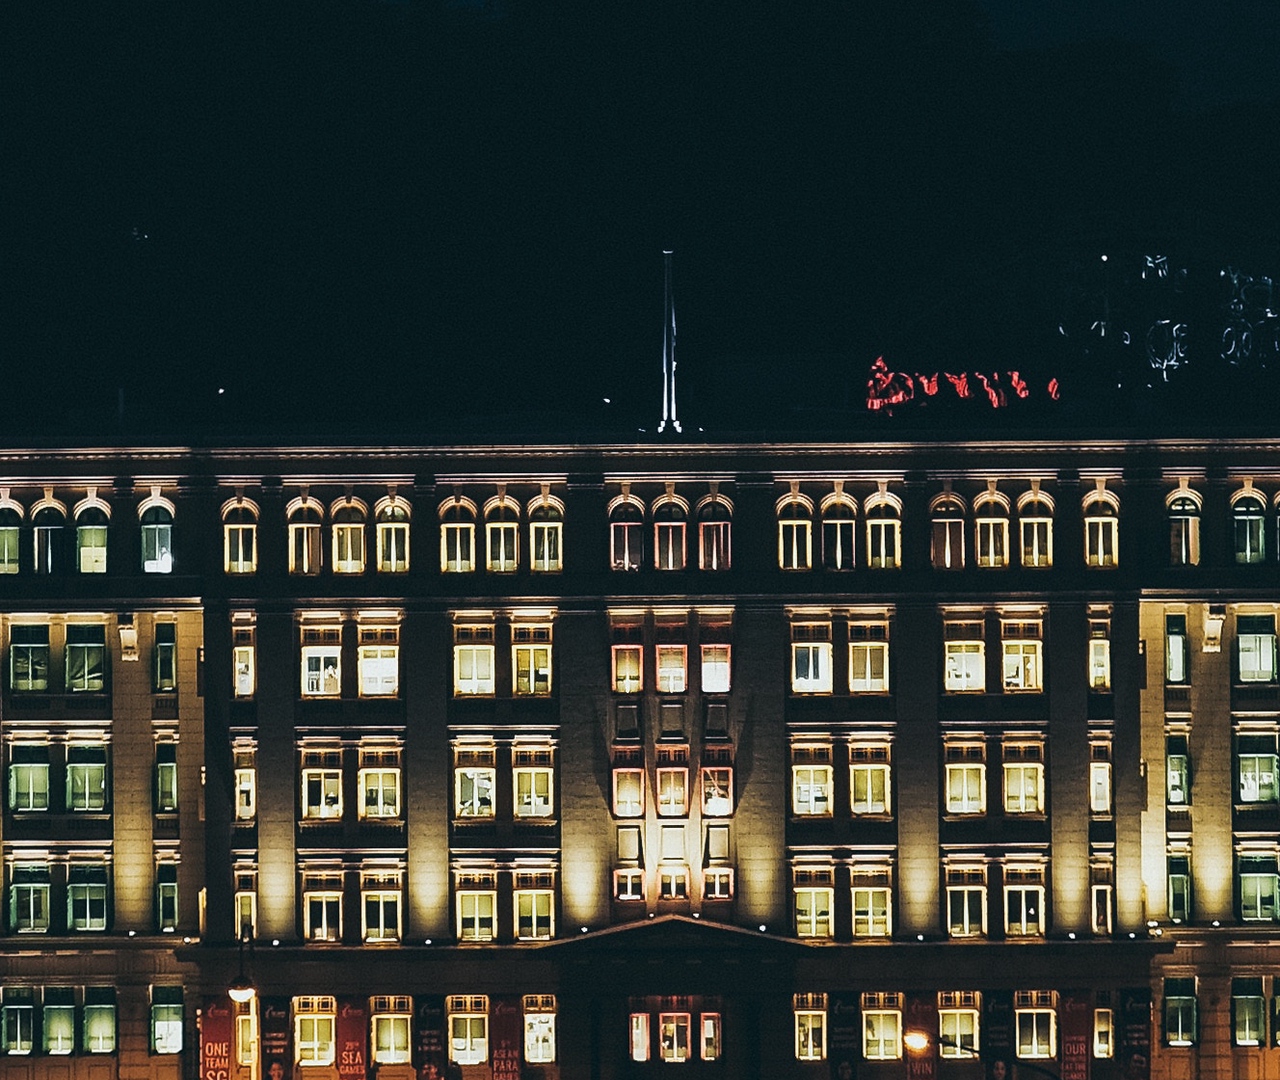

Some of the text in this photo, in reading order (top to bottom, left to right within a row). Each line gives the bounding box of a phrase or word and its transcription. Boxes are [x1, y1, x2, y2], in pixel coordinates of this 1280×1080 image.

[205, 1042, 229, 1056] ONE
[1065, 1043, 1086, 1055] OUR
[205, 1057, 229, 1069] TEAM
[342, 1051, 362, 1064] SEA
[340, 1065, 366, 1075] GAMES
[493, 1060, 519, 1071] PARA
[911, 1062, 932, 1076] WIN
